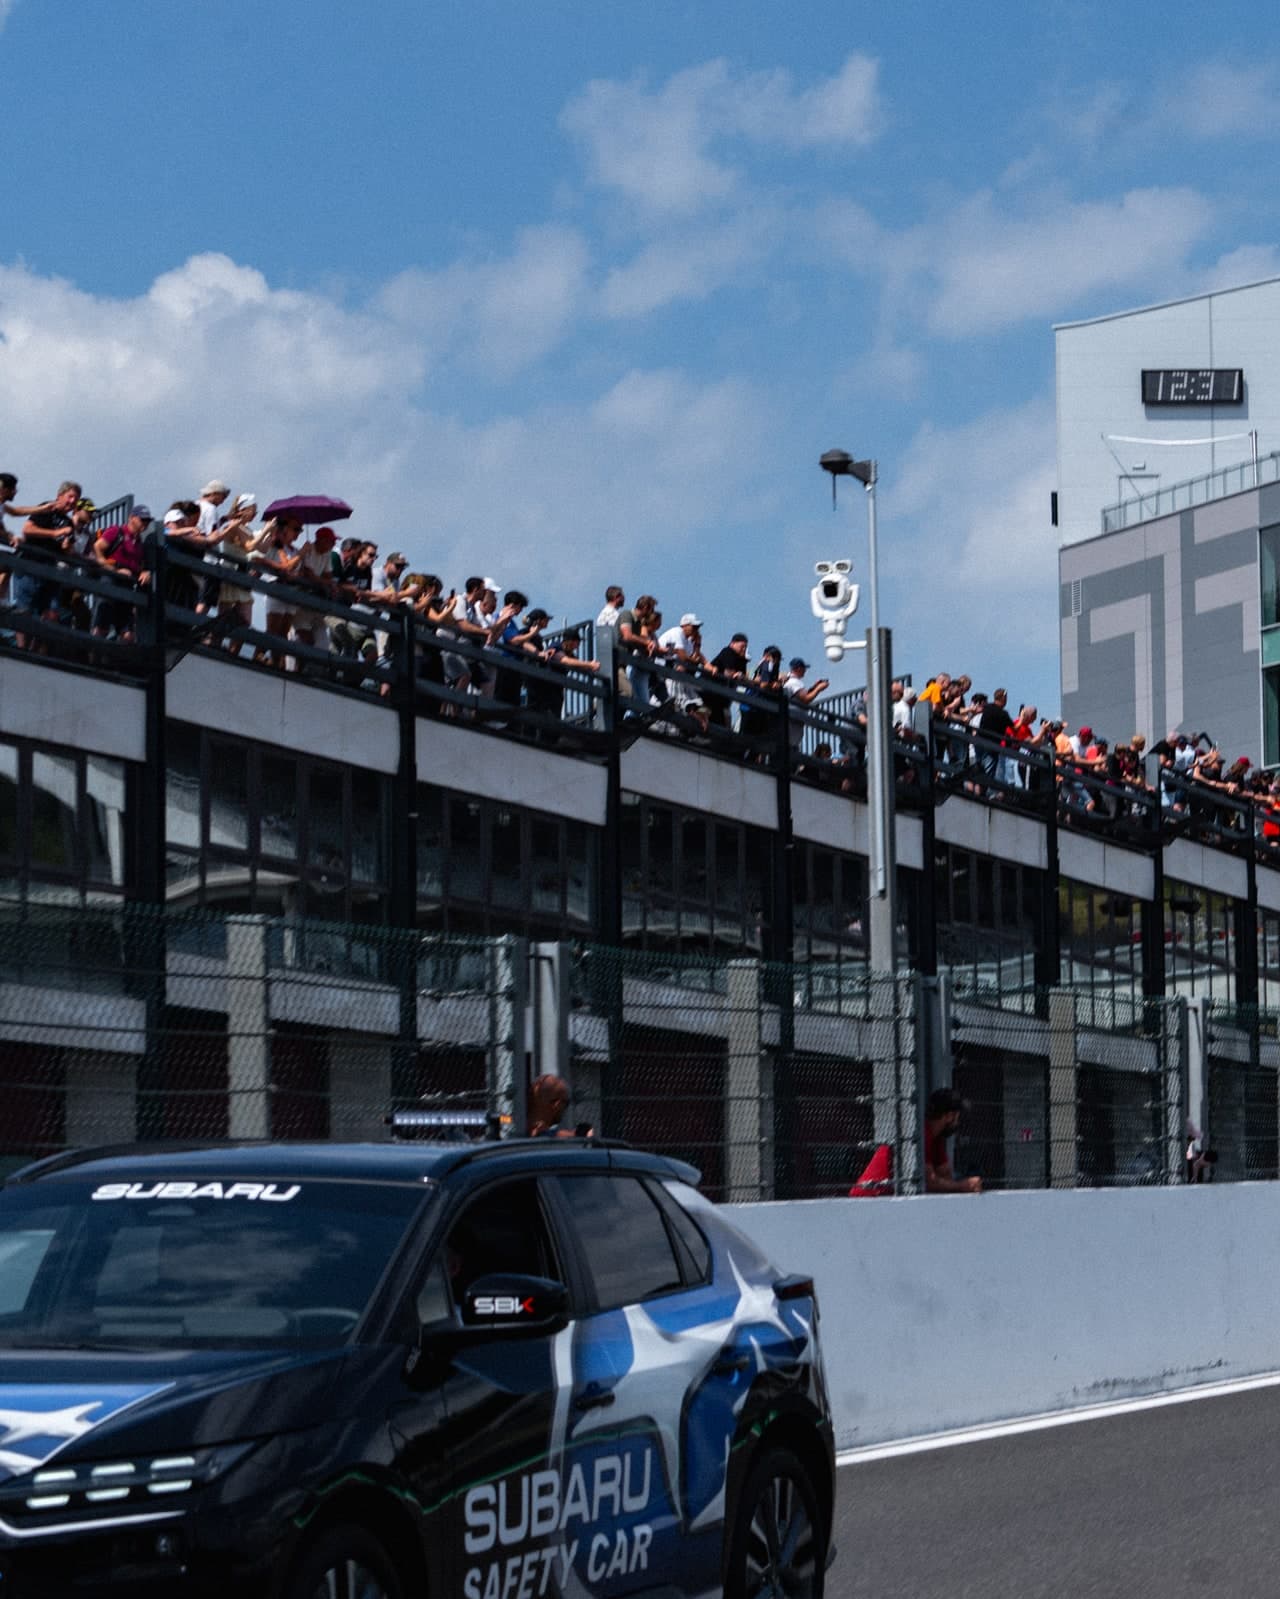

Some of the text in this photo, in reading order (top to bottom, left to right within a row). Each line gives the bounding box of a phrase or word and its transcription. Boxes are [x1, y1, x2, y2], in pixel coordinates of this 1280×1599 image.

[1157, 371, 1239, 401] 12:31
[91, 1182, 301, 1201] SUBARU
[474, 1297, 534, 1314] SBK
[464, 1448, 651, 1555] SUBARU
[464, 1524, 653, 1599] SAFETY CAR
